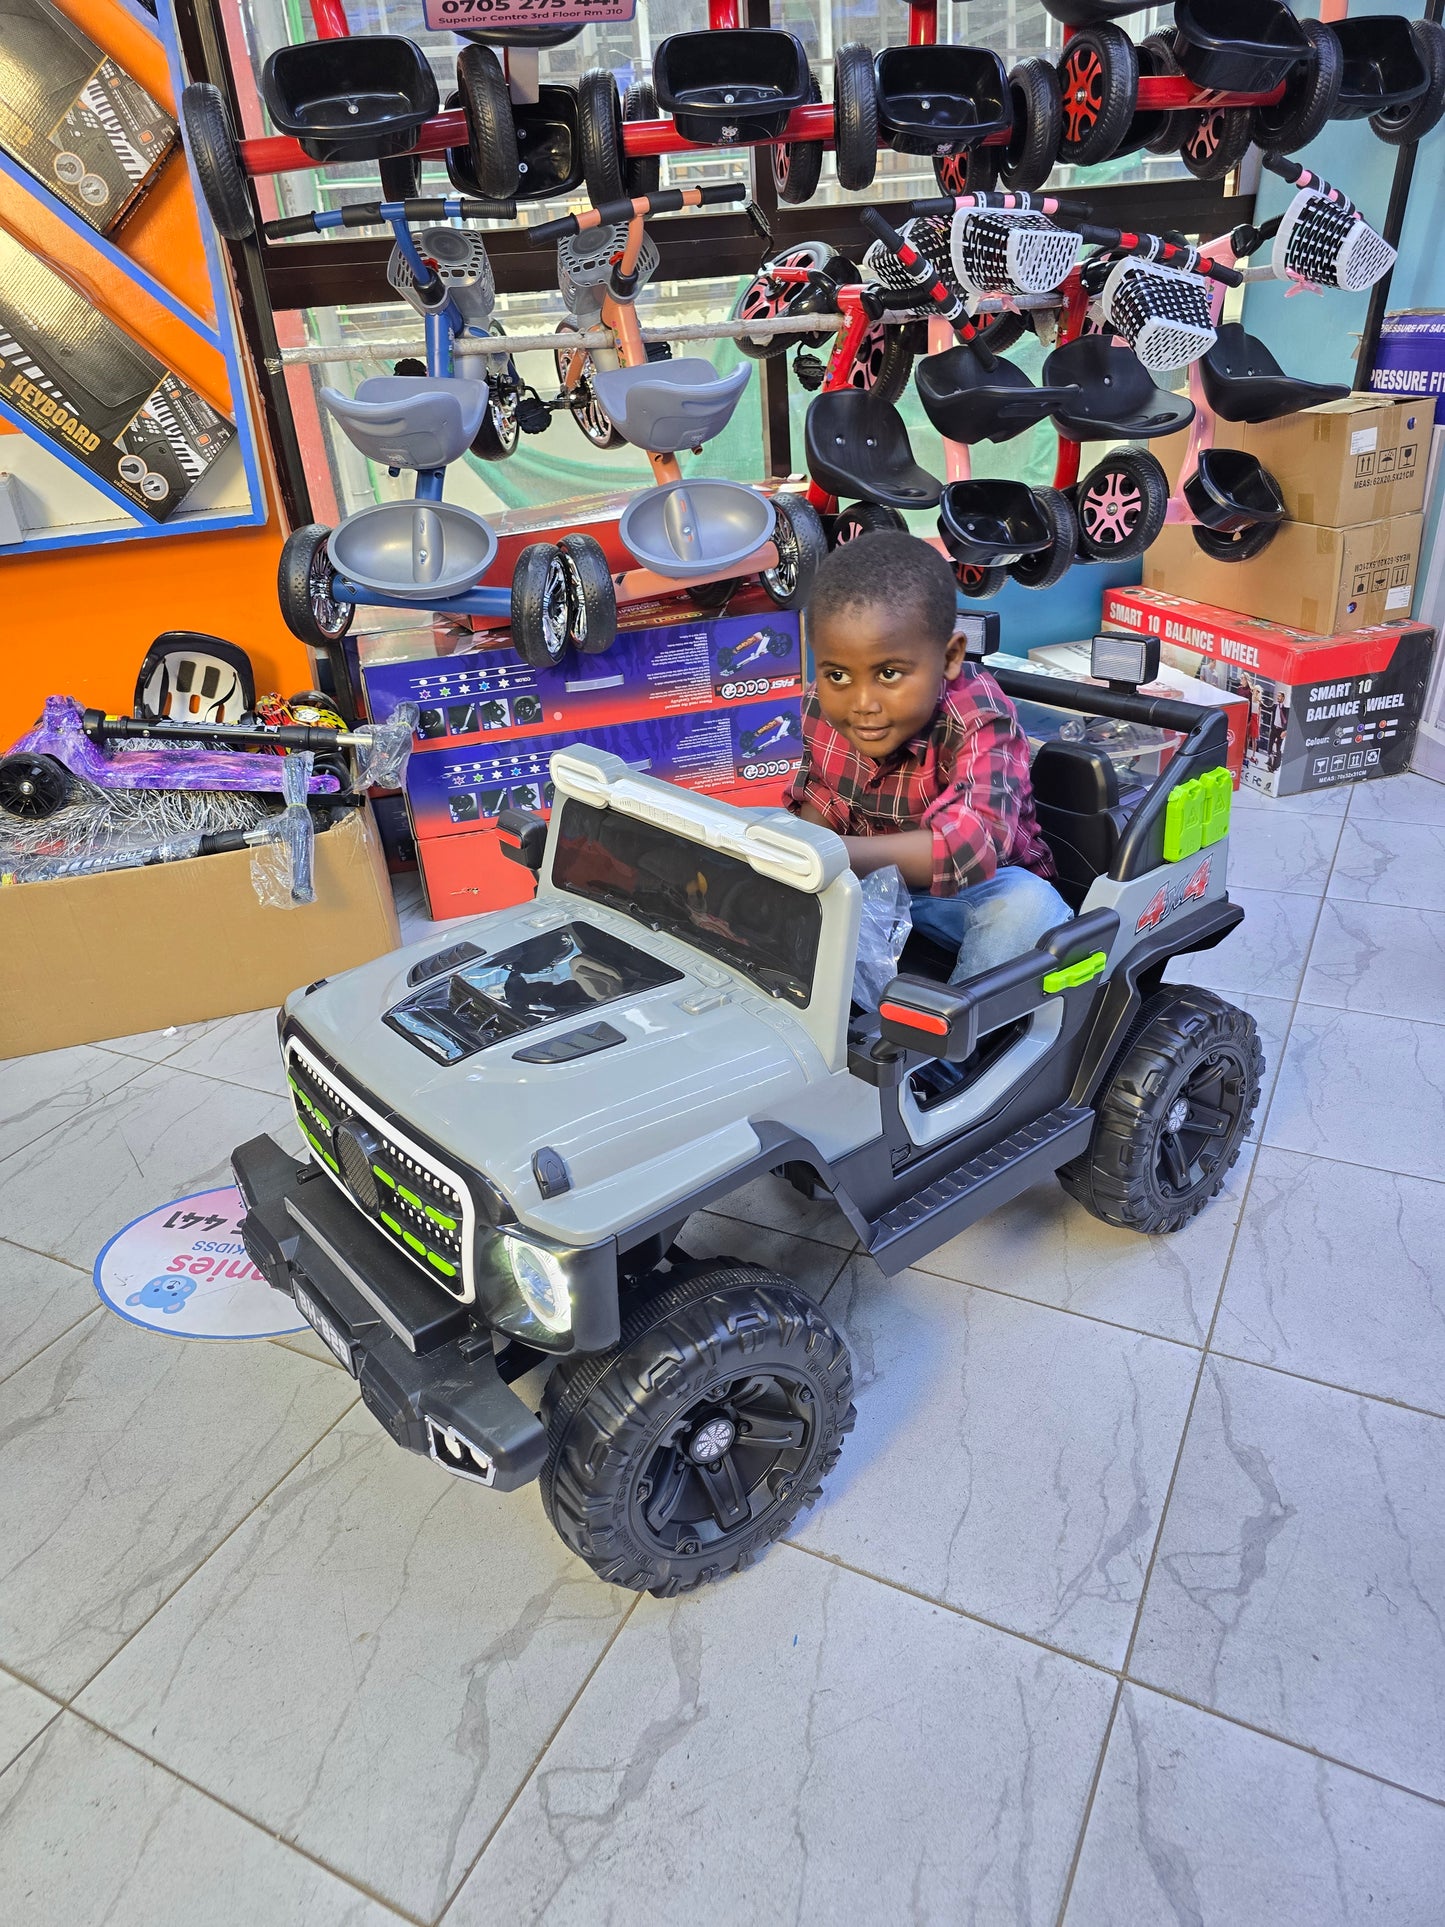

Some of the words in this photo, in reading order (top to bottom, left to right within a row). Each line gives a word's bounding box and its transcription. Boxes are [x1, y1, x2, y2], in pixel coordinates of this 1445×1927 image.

[438, 15, 487, 24] Superior
[10, 374, 101, 452] KEYBOARD
[1109, 601, 1143, 628] SMART
[1148, 614, 1160, 633] 10
[1165, 619, 1214, 653] BALANCE
[1220, 637, 1260, 668] WHEEL
[770, 677, 795, 690] FAST
[1309, 682, 1351, 703] SMART
[1358, 679, 1373, 694] 10
[1305, 700, 1360, 722] BALANCE
[1366, 693, 1405, 712] WHEEL
[1305, 736, 1330, 747] Colour:
[162, 1211, 229, 1231] 441
[192, 1240, 246, 1255] KIDSS
